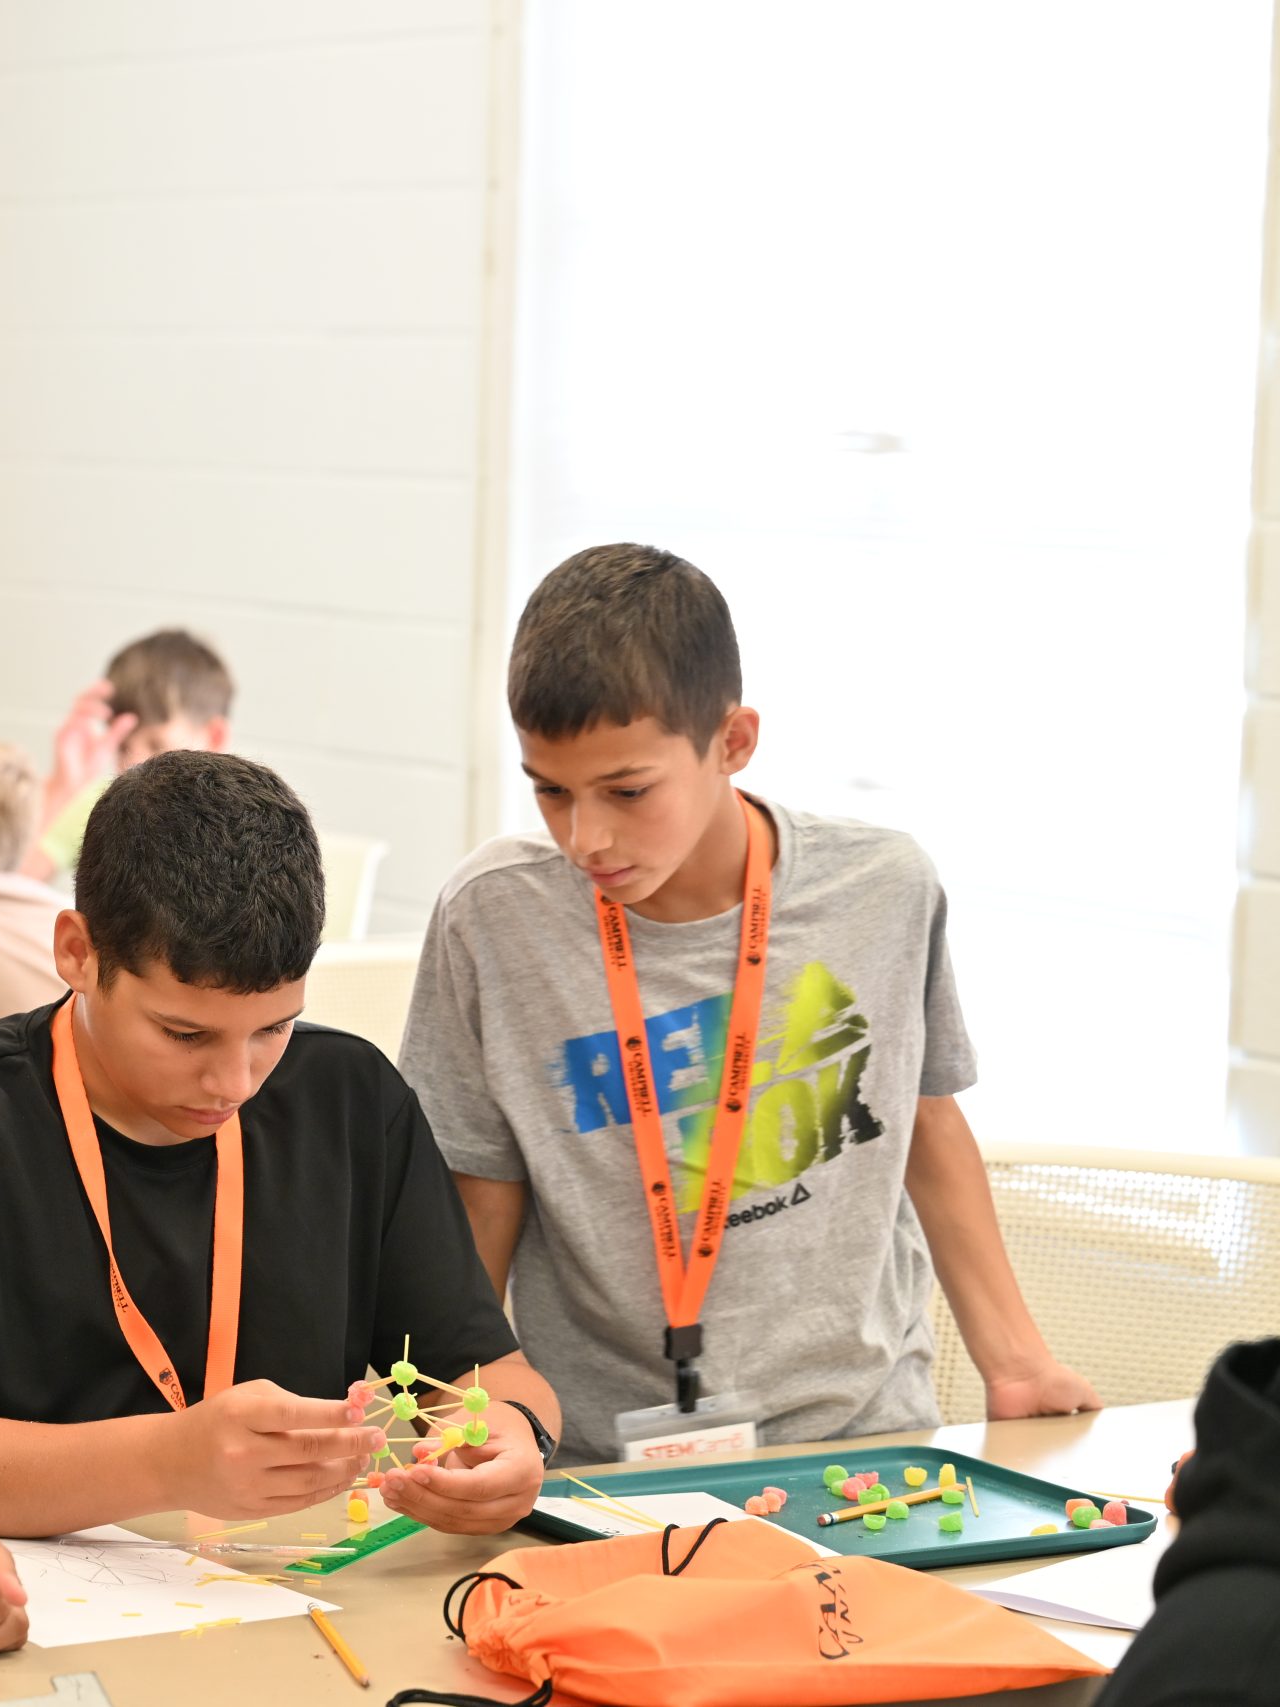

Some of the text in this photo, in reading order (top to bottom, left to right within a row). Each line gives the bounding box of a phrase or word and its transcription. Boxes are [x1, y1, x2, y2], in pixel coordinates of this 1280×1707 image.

[608, 906, 627, 971] CAMPBELL
[633, 1053, 653, 1118] CAMPBELL
[723, 1196, 789, 1229] eebok
